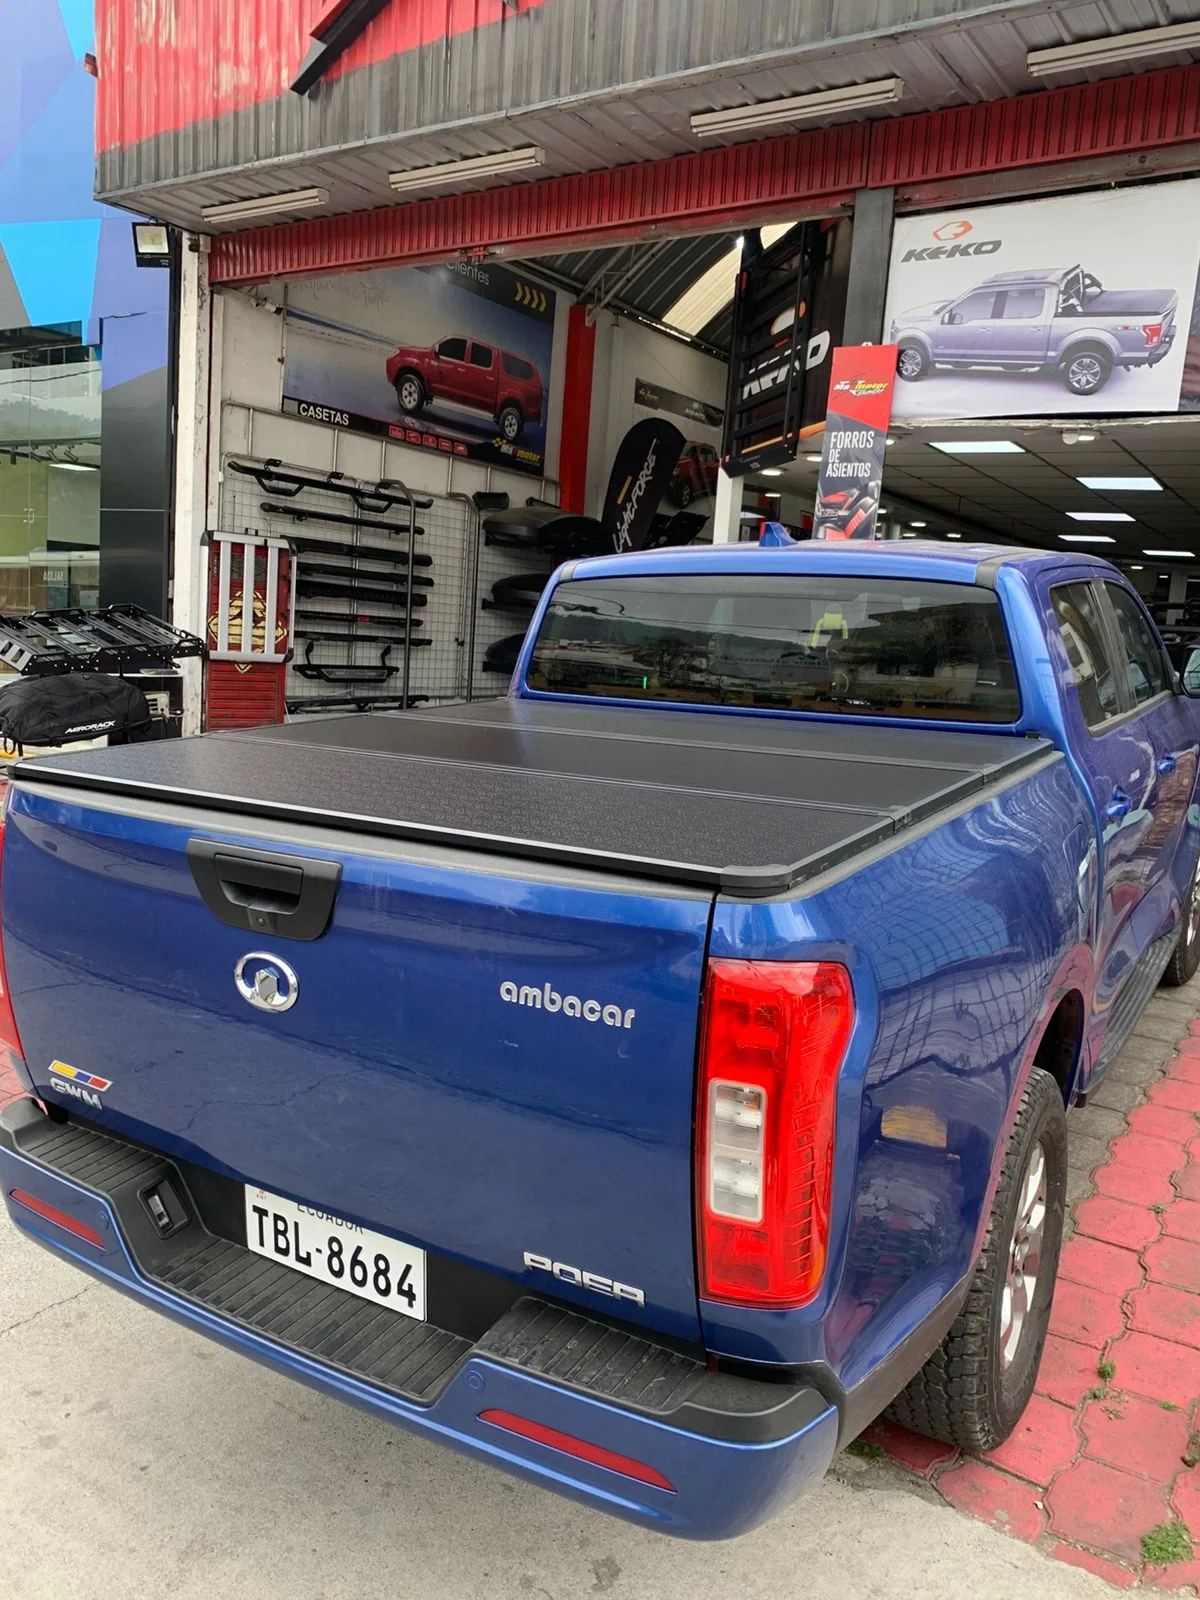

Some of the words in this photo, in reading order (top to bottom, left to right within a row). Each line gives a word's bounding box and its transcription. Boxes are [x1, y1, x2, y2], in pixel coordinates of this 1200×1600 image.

[901, 240, 1002, 263] KEKO
[300, 403, 349, 426] CASETAS
[830, 430, 875, 449] FORROS
[828, 448, 841, 463] DE
[825, 462, 872, 478] ASIENTOS
[499, 981, 636, 1029] ambacar
[50, 1077, 103, 1110] GWM
[252, 1204, 416, 1309] TBL-8684
[523, 1251, 646, 1308] POER
